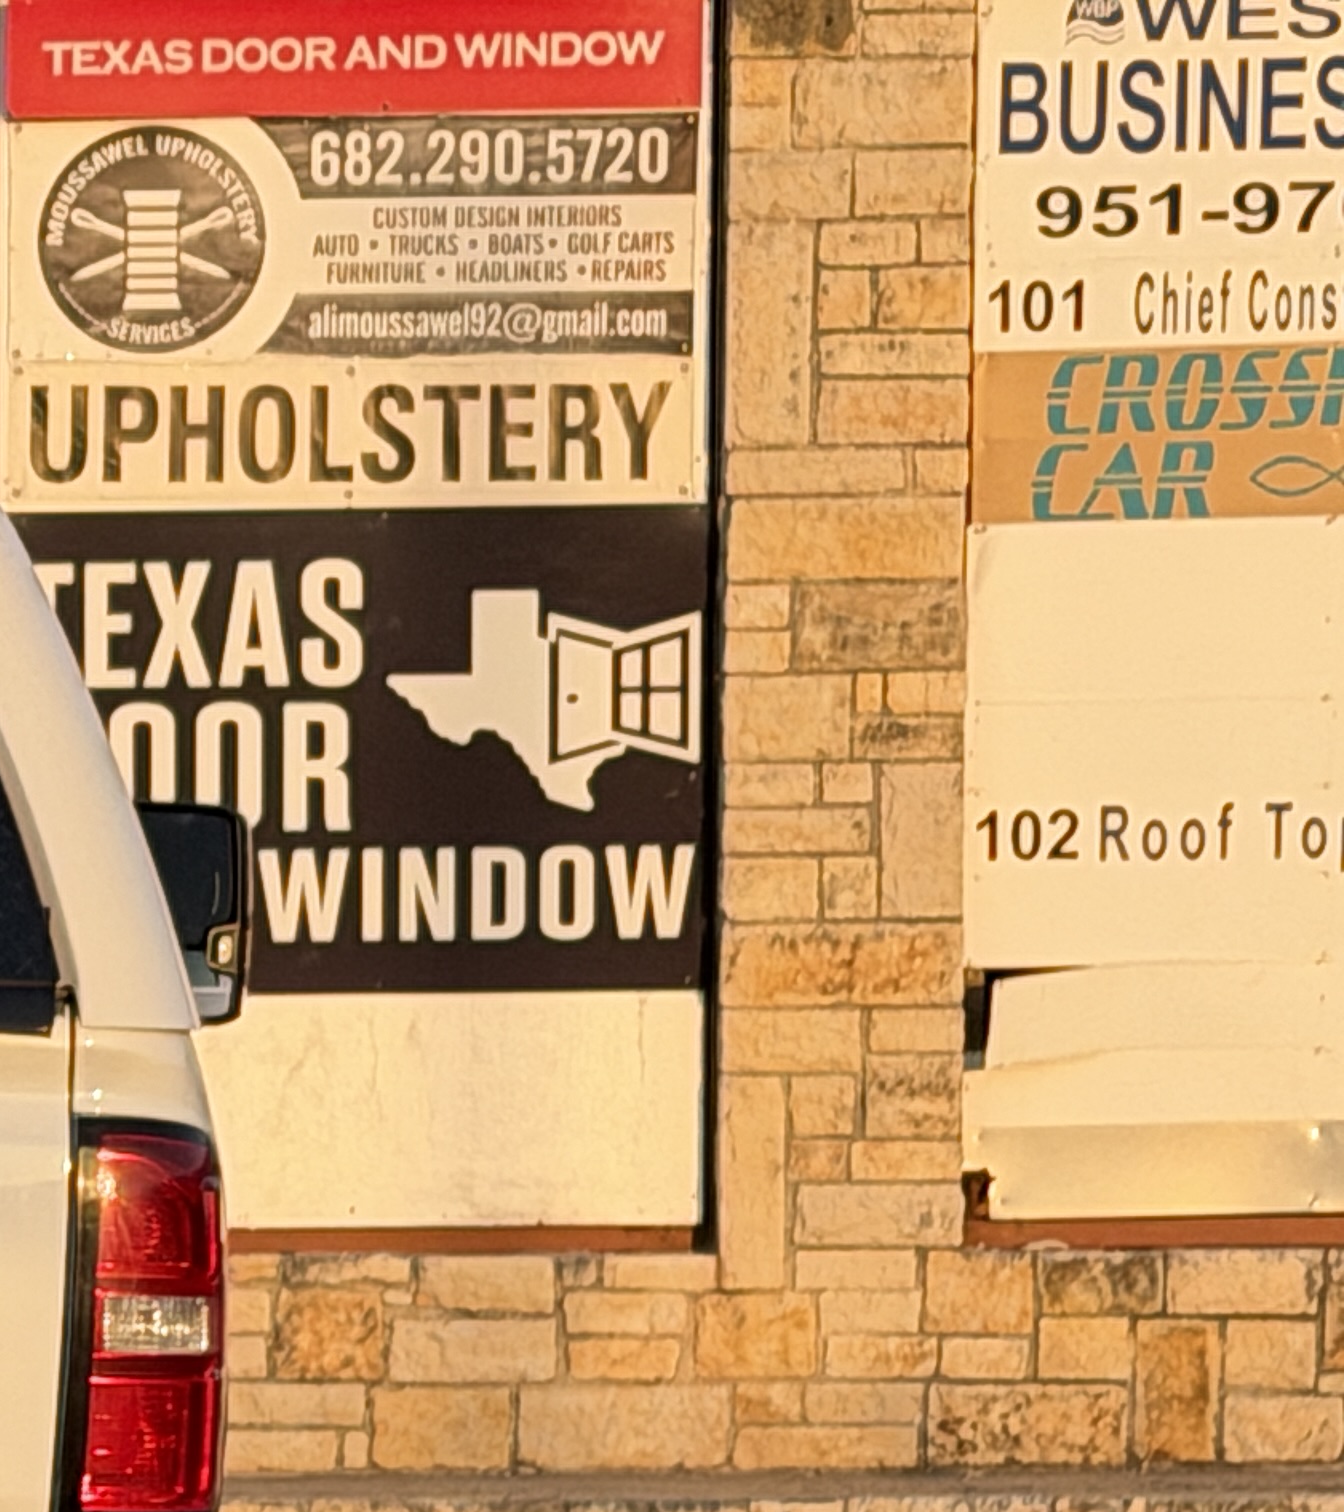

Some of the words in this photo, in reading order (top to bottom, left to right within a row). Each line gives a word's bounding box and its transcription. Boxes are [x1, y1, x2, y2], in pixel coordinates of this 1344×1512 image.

[41, 39, 194, 77] TEXAS
[201, 36, 335, 73] DOOR
[344, 33, 448, 71] AND
[455, 29, 666, 68] WINDOW
[310, 127, 670, 186] 682.290.5720
[45, 133, 149, 247] MOUSSAWEL
[155, 133, 261, 246] UPHOLSTERY
[373, 206, 448, 229] CUSTOM
[454, 206, 520, 227] DESIGN
[527, 204, 623, 228] INTERIORS
[1035, 181, 1344, 238] 951-97
[313, 234, 360, 257] AUTO
[389, 234, 459, 256] TRUCKS
[488, 233, 545, 255] BOATS
[567, 233, 613, 254] GOLF
[617, 231, 675, 255] CARTS
[326, 261, 427, 284] FURNITURE
[456, 260, 568, 284] HEADLINERS
[591, 259, 667, 283] REPAIRS
[105, 315, 197, 345] SERVICES
[308, 302, 669, 343] alimoussawel92@gmail.com
[988, 279, 1086, 333] 101
[1134, 270, 1232, 334] Chief
[1248, 269, 1344, 333] Cons
[28, 380, 672, 485] UPHOLSTERY
[1031, 440, 1214, 521] CAR
[975, 808, 1080, 861] 102
[1099, 801, 1235, 862] Roof
[1265, 801, 1344, 873] To
[258, 844, 696, 943] WINDOW
